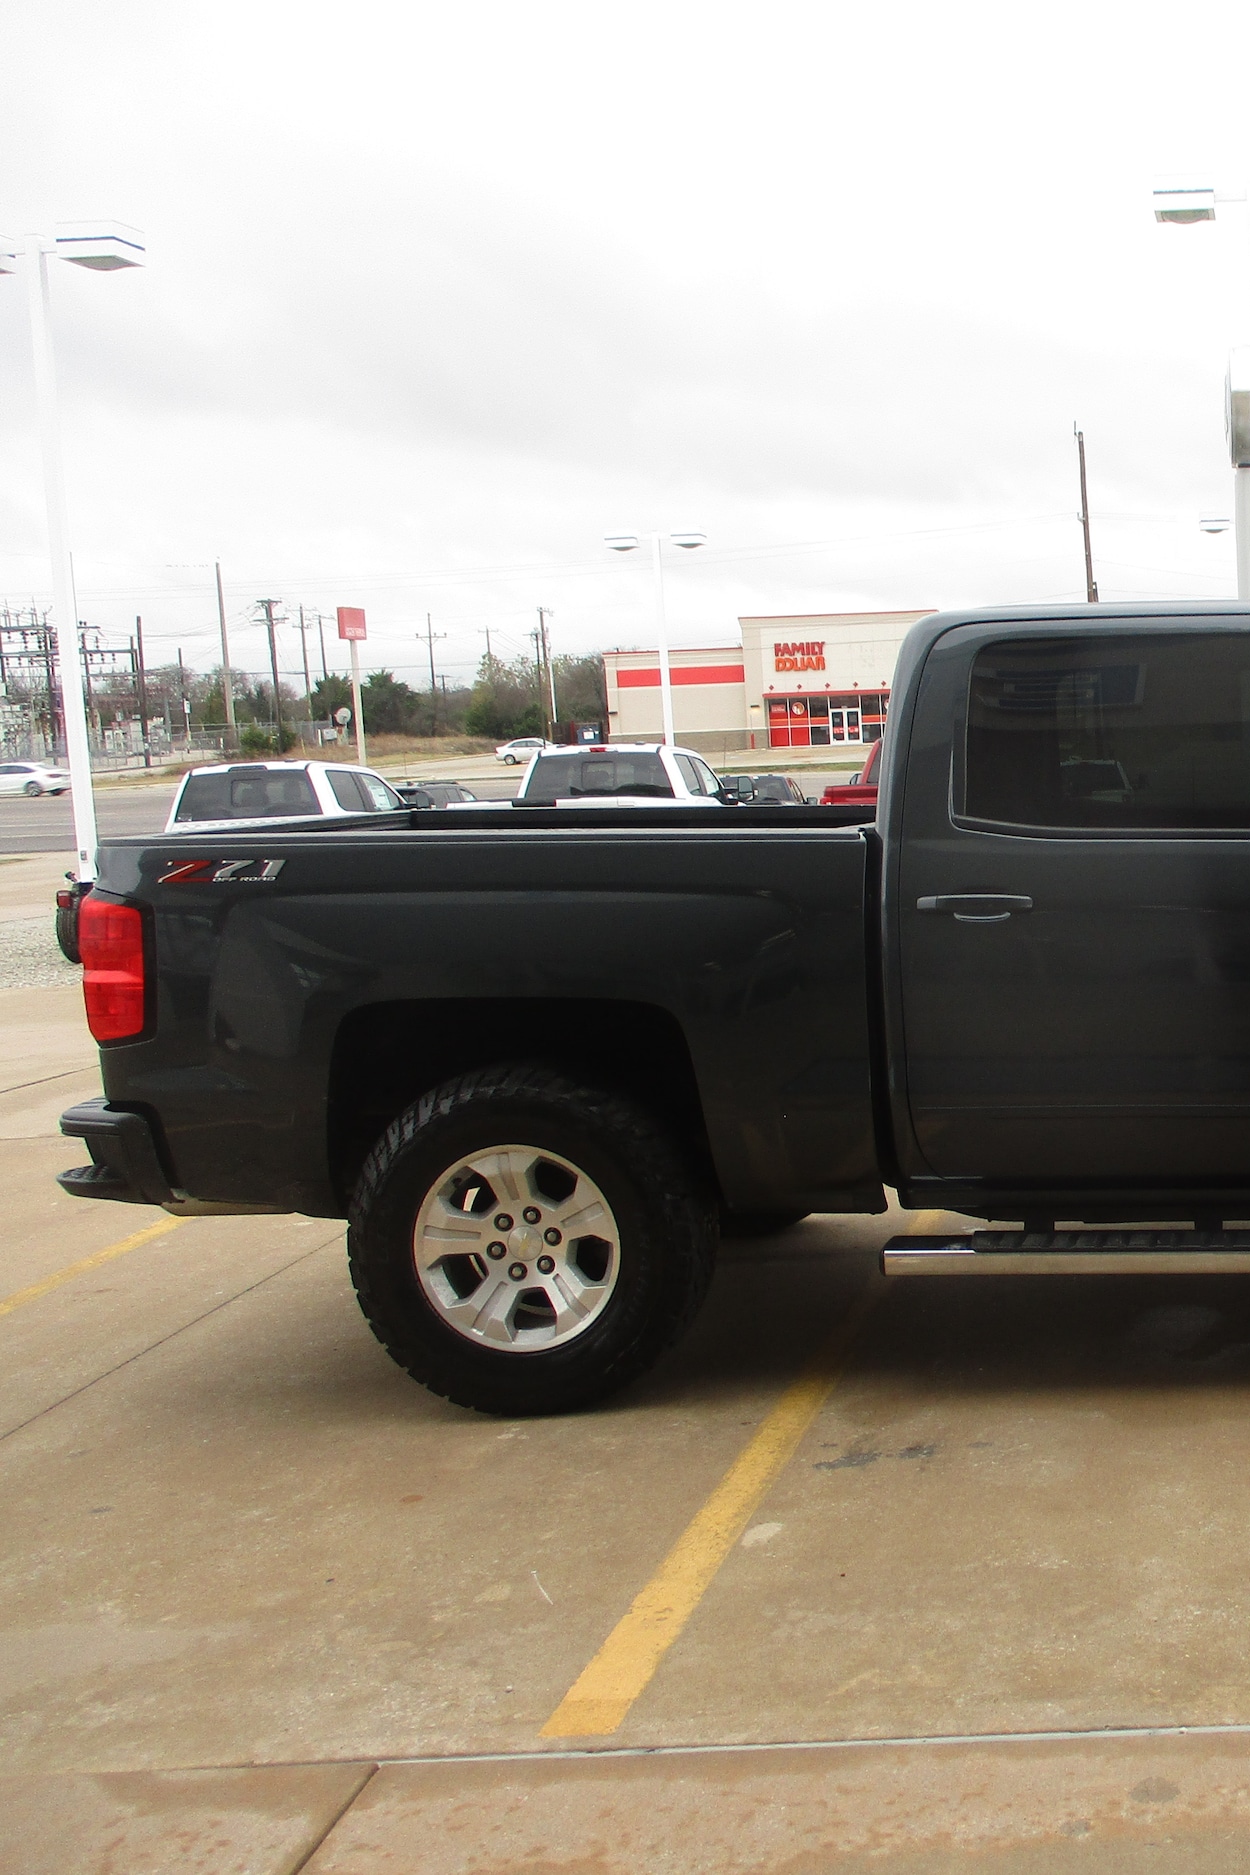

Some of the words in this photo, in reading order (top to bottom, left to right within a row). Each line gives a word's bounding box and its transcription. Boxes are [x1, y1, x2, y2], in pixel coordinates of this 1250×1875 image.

[774, 641, 825, 656] FAMILY
[775, 655, 826, 672] DOLLAR
[157, 859, 286, 883] Z71
